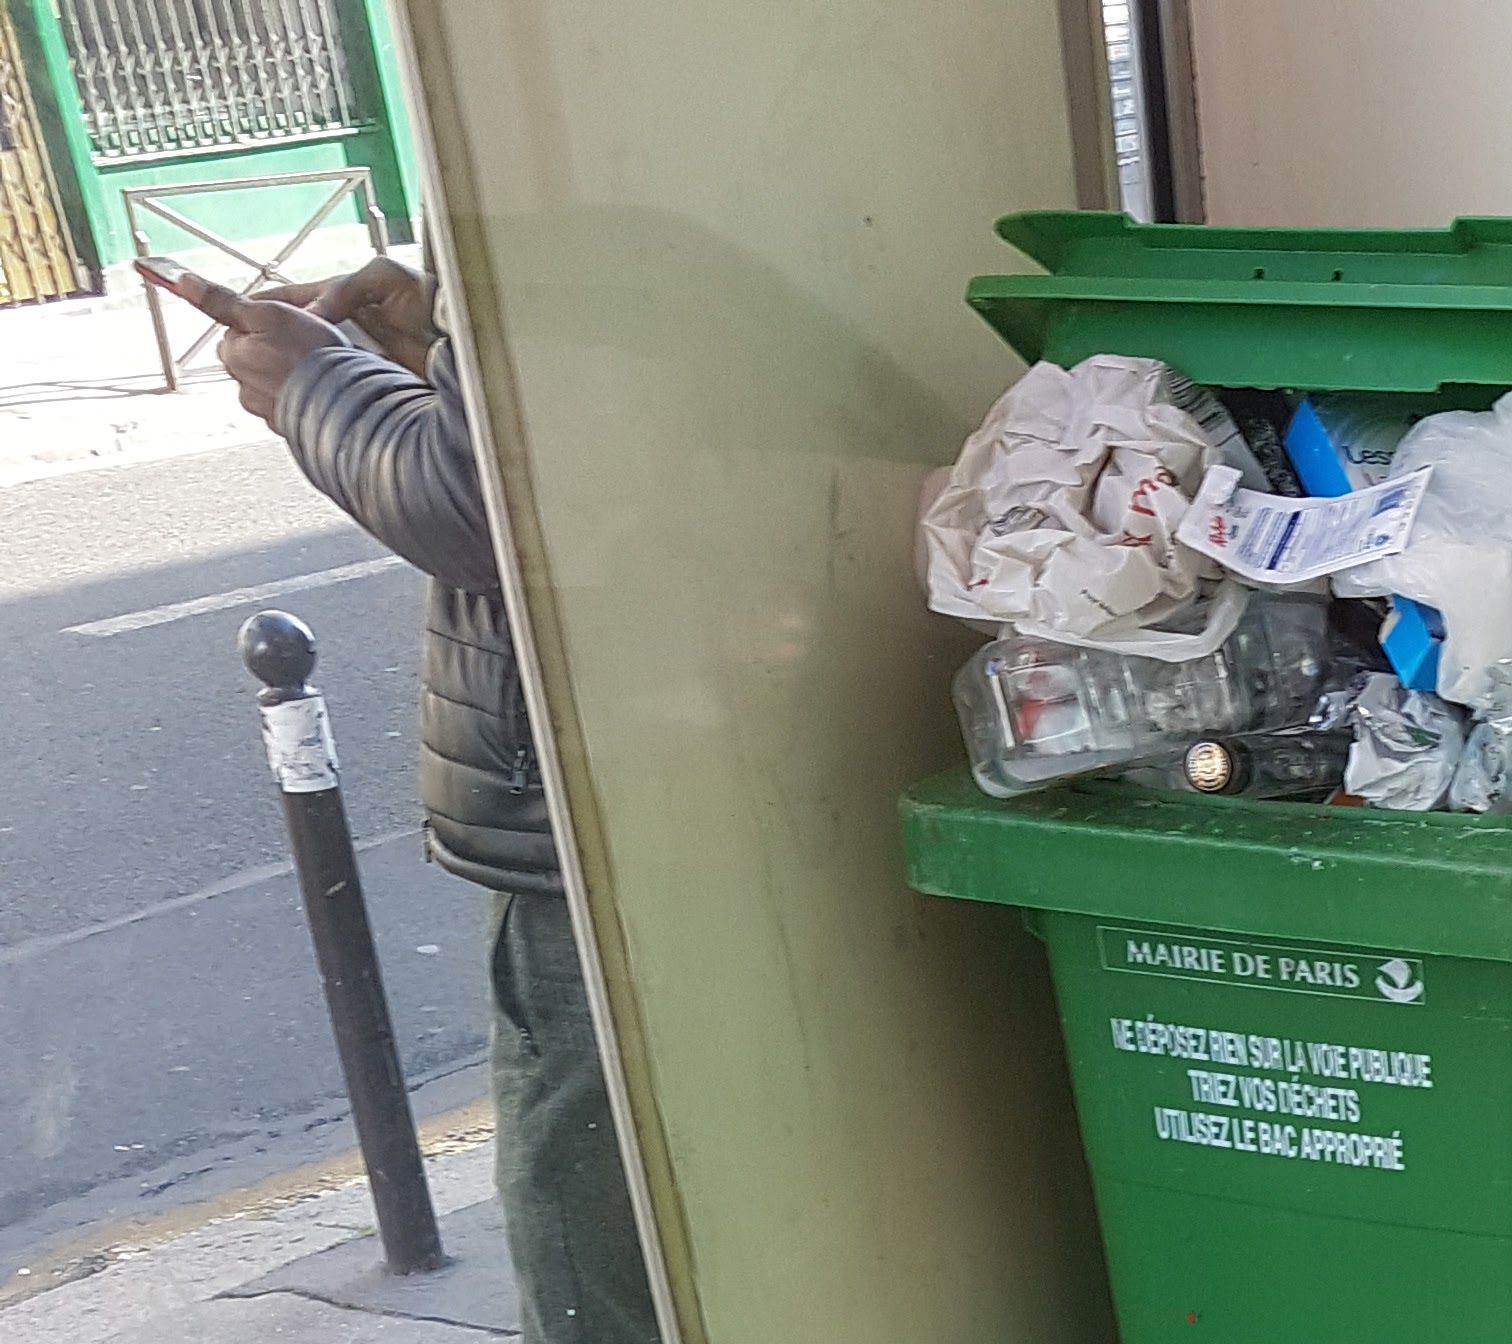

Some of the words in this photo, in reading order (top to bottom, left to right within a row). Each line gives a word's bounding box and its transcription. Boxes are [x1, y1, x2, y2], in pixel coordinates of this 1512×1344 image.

[1126, 939, 1225, 974] MAIRIE
[1233, 953, 1271, 979] DE
[1279, 958, 1360, 988] PARIS
[1110, 1017, 1135, 1052] NE
[1136, 1013, 1211, 1061] DÉPOSEZ
[1211, 1032, 1247, 1067] RIEN
[1248, 1036, 1282, 1070] SUR
[1284, 1039, 1309, 1074] LA
[1309, 1043, 1349, 1078] VOIE
[1349, 1047, 1433, 1089] PUBLIQUE
[1187, 1069, 1239, 1107] TRIEZ
[1239, 1075, 1277, 1112] VOS
[1278, 1075, 1361, 1123] DÉCHETS
[1153, 1107, 1231, 1149] UTILISEZ
[1232, 1116, 1257, 1152] LE
[1259, 1120, 1298, 1158] BAC
[1300, 1130, 1405, 1170] APPROPRIÉ
